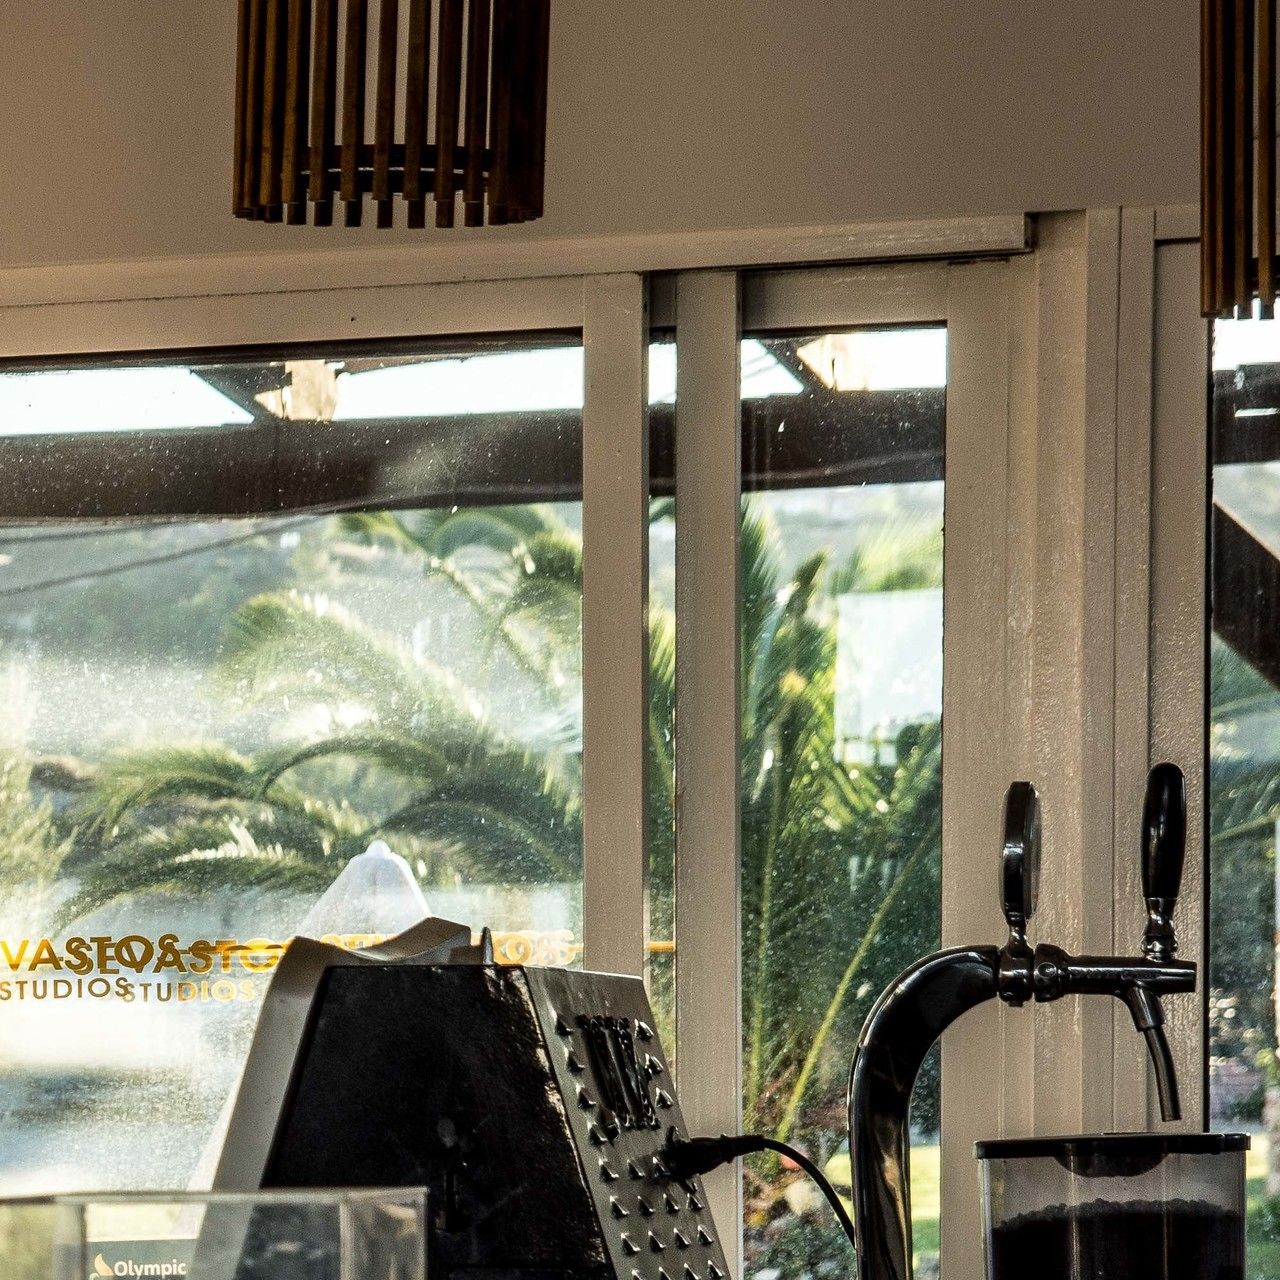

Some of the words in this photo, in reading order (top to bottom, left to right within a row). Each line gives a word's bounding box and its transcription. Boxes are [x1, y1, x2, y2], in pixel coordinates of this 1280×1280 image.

[73, 937, 294, 976] SEVASTO
[123, 979, 257, 1003] STUDIOS
[114, 1258, 187, 1280] Olympic
